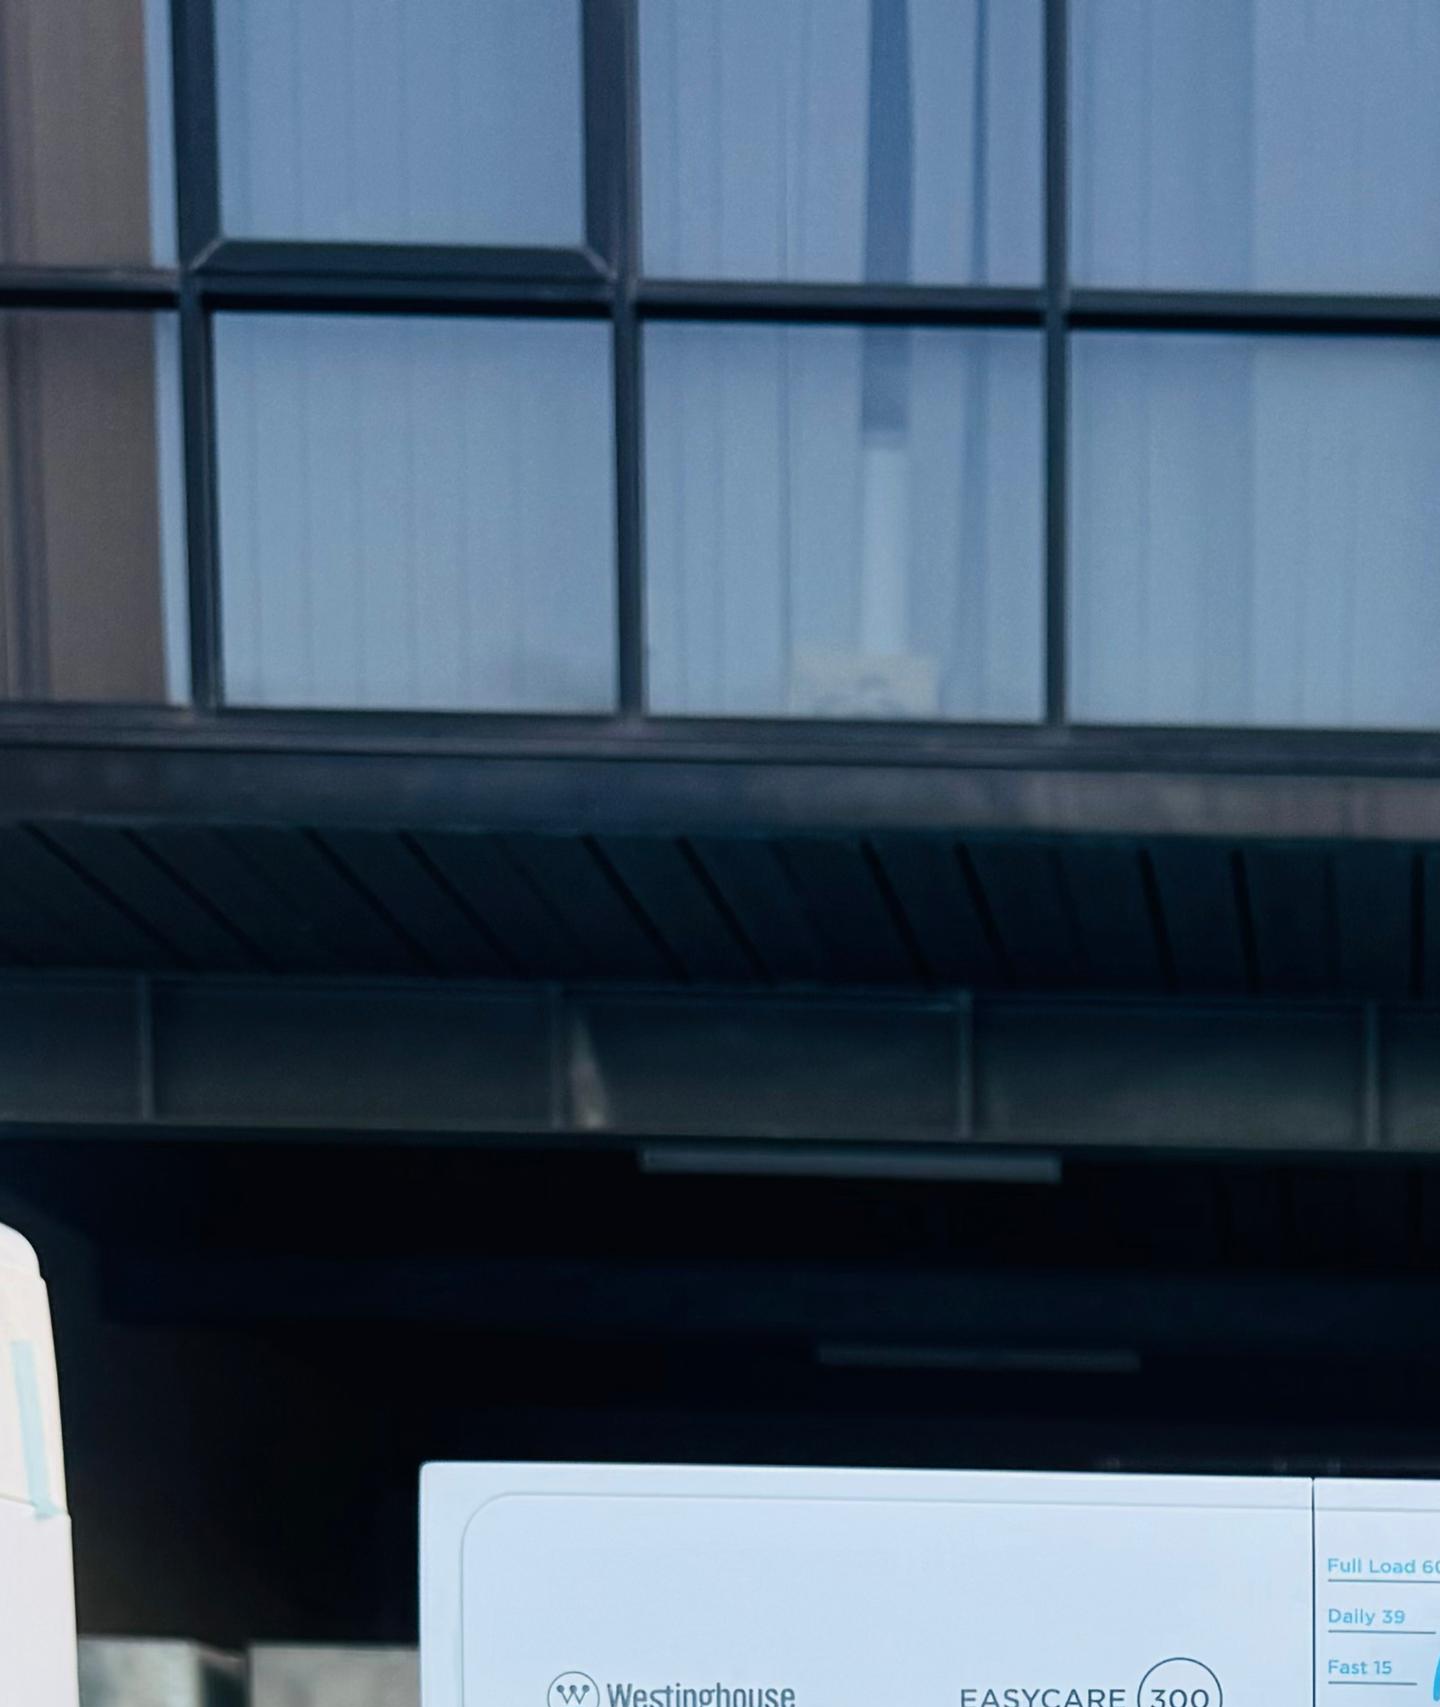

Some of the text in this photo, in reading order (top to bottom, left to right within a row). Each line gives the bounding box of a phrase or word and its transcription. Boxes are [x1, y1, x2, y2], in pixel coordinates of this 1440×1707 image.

[1328, 1558, 1362, 1573] Full
[1369, 1559, 1416, 1574] Load
[1328, 1608, 1405, 1626] Daily 39
[1328, 1659, 1392, 1675] Fast 15
